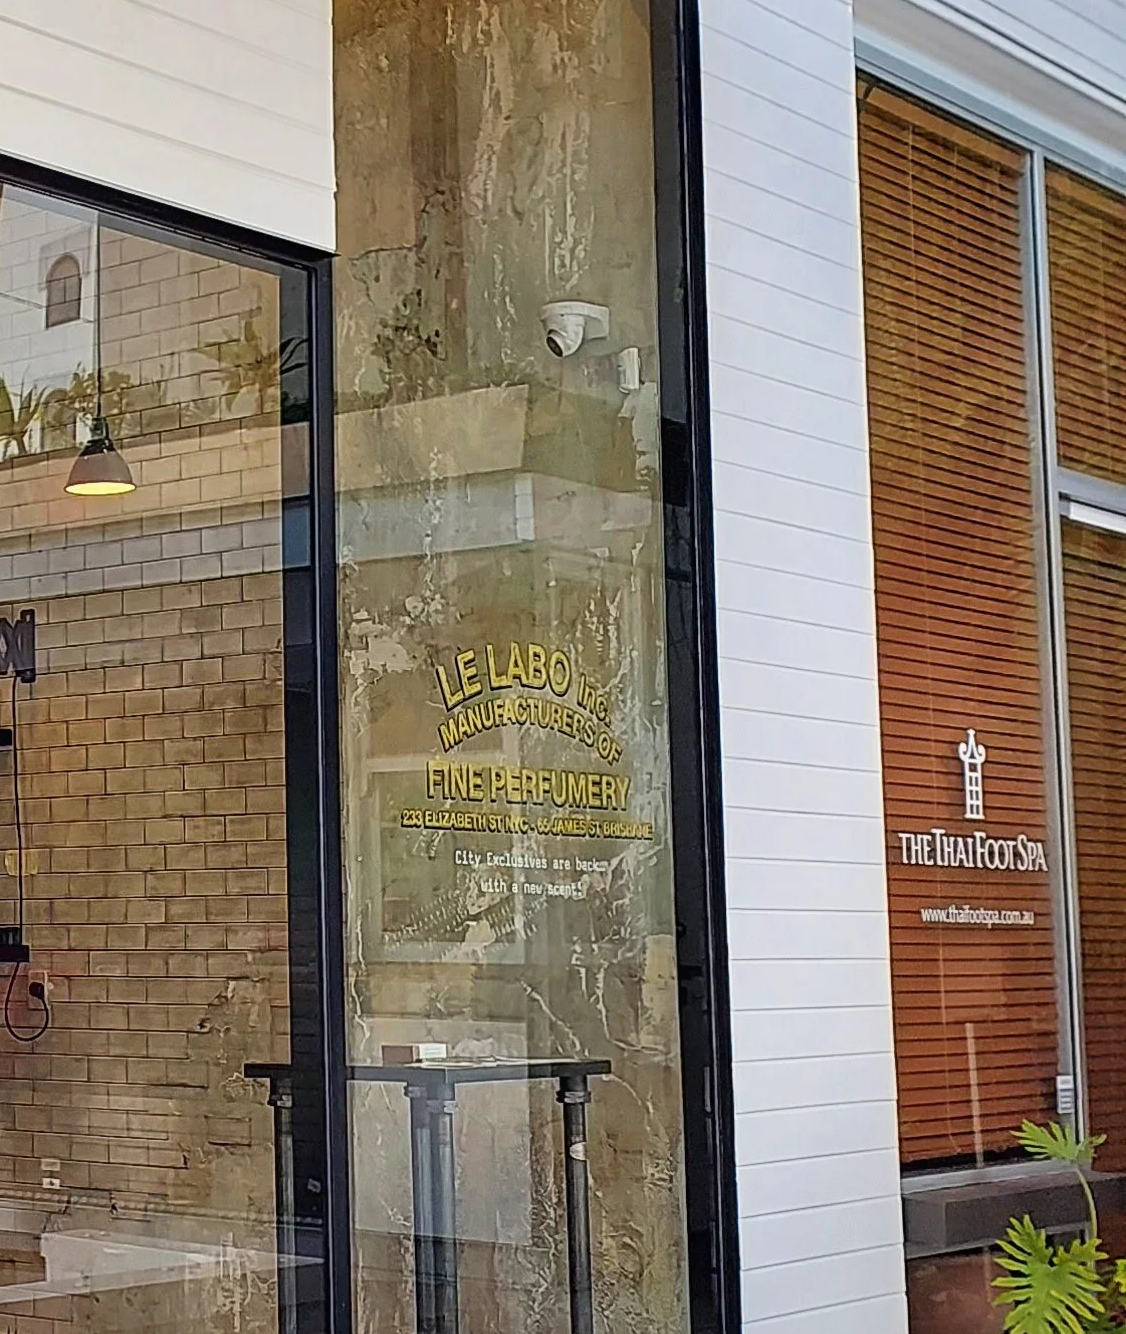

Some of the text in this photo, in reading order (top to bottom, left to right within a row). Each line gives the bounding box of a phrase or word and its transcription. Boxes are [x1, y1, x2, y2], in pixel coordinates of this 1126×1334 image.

[436, 649, 482, 712] LE
[485, 641, 572, 697] LABO
[438, 697, 623, 765] MANUFACTURERS OF
[426, 760, 631, 811] FINE PERFUMERY
[401, 809, 423, 828] 233
[424, 809, 487, 832] ELIZABETH
[503, 814, 529, 835] NYC
[551, 816, 587, 837] JAMES
[455, 850, 481, 868] City
[486, 852, 547, 870] Exclusives
[552, 858, 571, 870] are
[898, 832, 934, 866] THE
[480, 877, 506, 893] with
[511, 882, 519, 893] a
[524, 882, 543, 895] new
[921, 905, 1034, 928] www.thaifootspa.com.au
